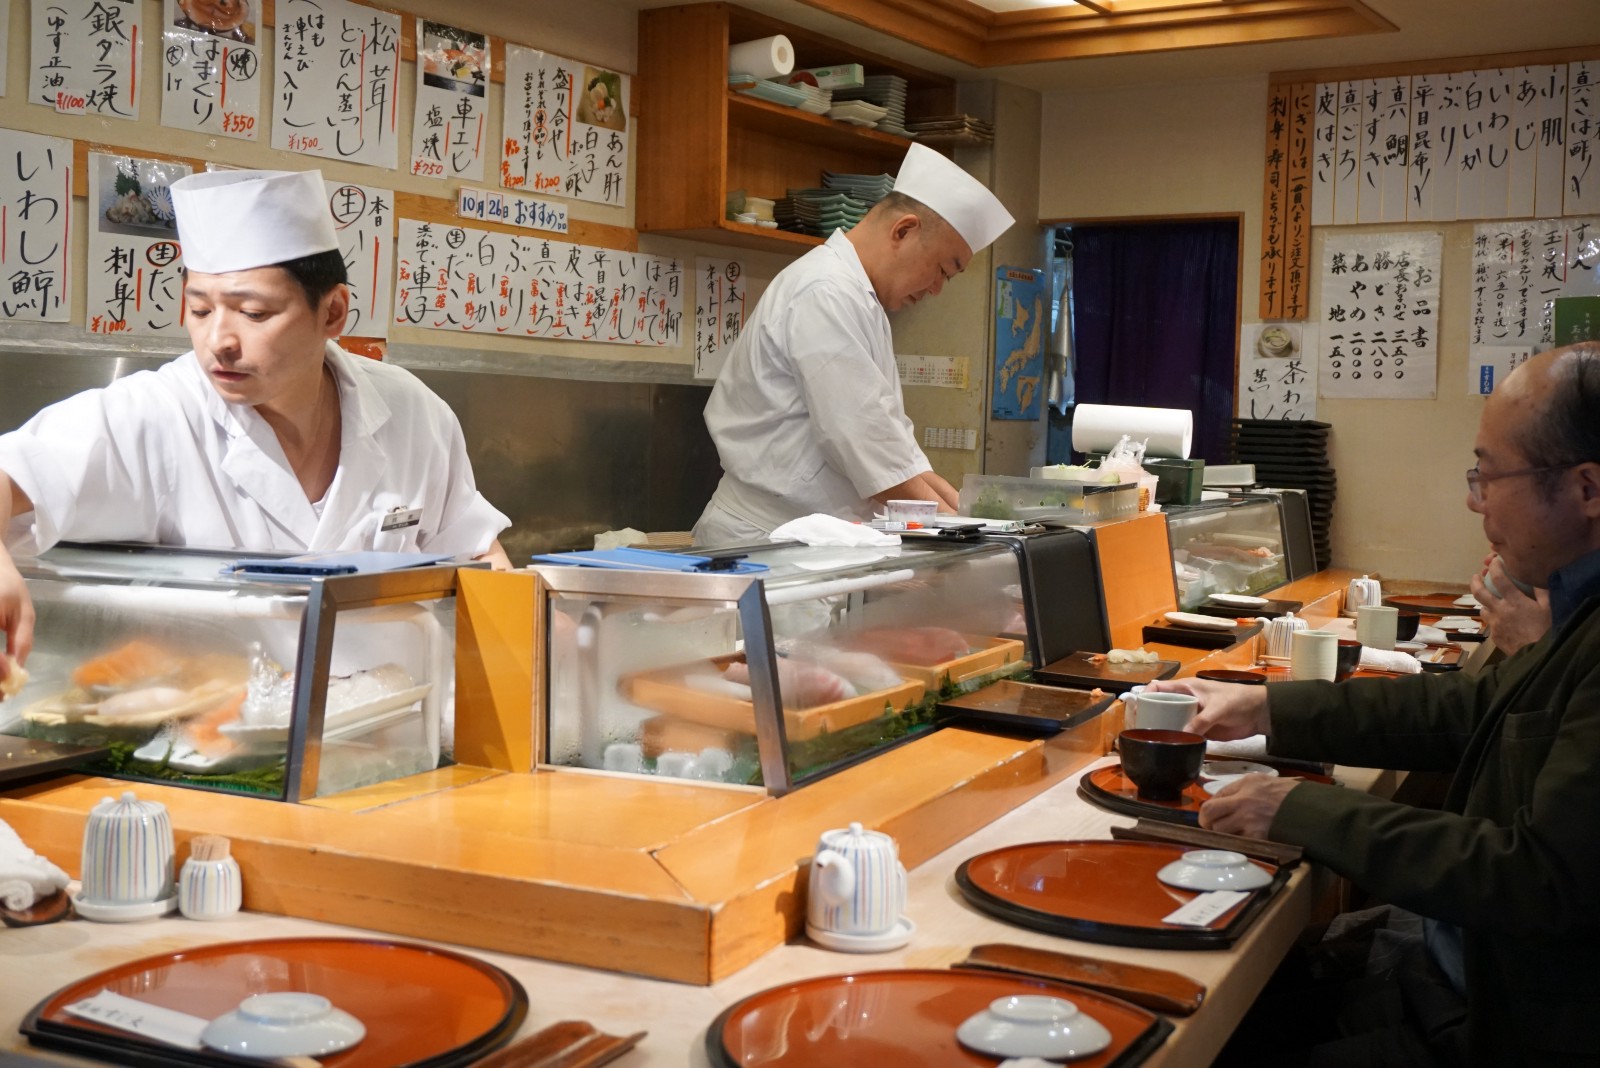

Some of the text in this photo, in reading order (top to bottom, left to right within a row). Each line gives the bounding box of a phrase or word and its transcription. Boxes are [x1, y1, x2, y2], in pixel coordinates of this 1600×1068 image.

[82, 2, 134, 116] 銀ダラ焼
[191, 39, 222, 125] はまぐり
[327, 19, 364, 156] どびん蒸し
[363, 17, 397, 147] 松茸
[422, 104, 443, 161] 塩焼
[450, 96, 478, 173] 車エビ
[1316, 91, 1335, 183] 皮はぎ
[1339, 89, 1360, 181] 真ごち
[1364, 90, 1385, 188] すずき
[1383, 86, 1408, 166] 真鯛
[1439, 86, 1461, 166] ぶり
[1462, 82, 1482, 171] 白いか
[1489, 84, 1510, 168] いわし
[1516, 80, 1536, 150] あじ
[1541, 76, 1564, 146] 小肌
[604, 131, 623, 203] あん肝
[368, 196, 389, 228] 本日
[105, 246, 135, 322] 刺身
[505, 239, 531, 327] ぶり
[618, 257, 636, 339] いわし
[644, 261, 661, 341] ほたて
[665, 259, 682, 343] 青柳
[1328, 252, 1347, 322] 築地
[1350, 253, 1369, 321] あやめ
[1411, 266, 1432, 348] お品書
